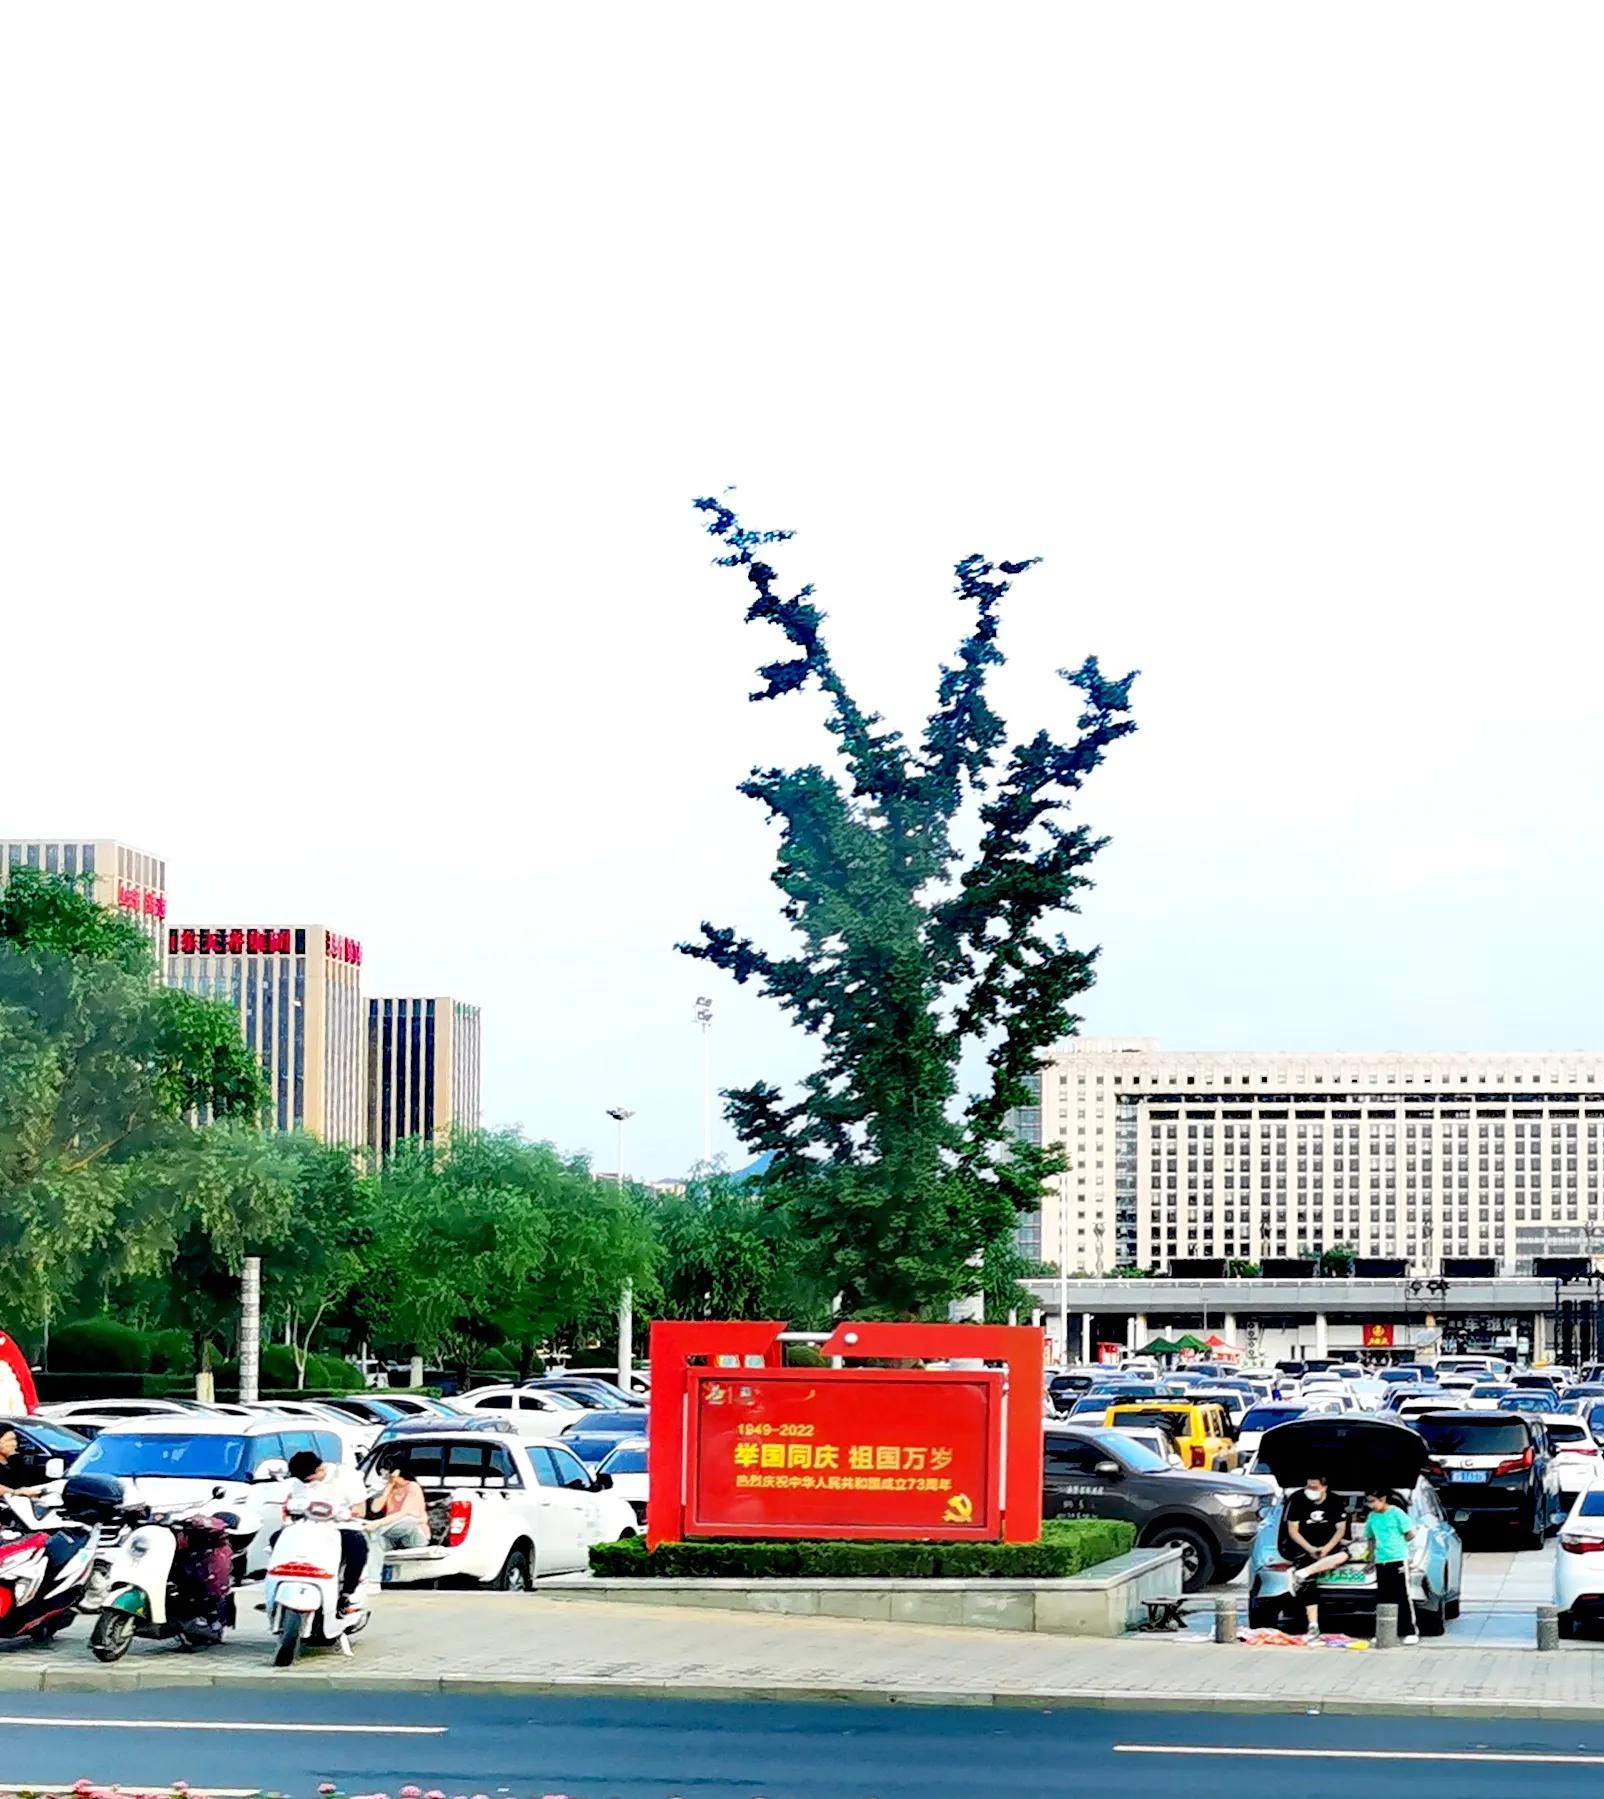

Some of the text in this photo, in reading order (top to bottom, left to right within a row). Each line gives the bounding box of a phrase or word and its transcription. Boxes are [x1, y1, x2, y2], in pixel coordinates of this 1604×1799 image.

[737, 1424, 815, 1437] 1949-2022
[734, 1443, 953, 1470] 举国同庆 祖国万岁
[736, 1475, 953, 1491] 热烈庆祝中华人民共和国成立73周年
